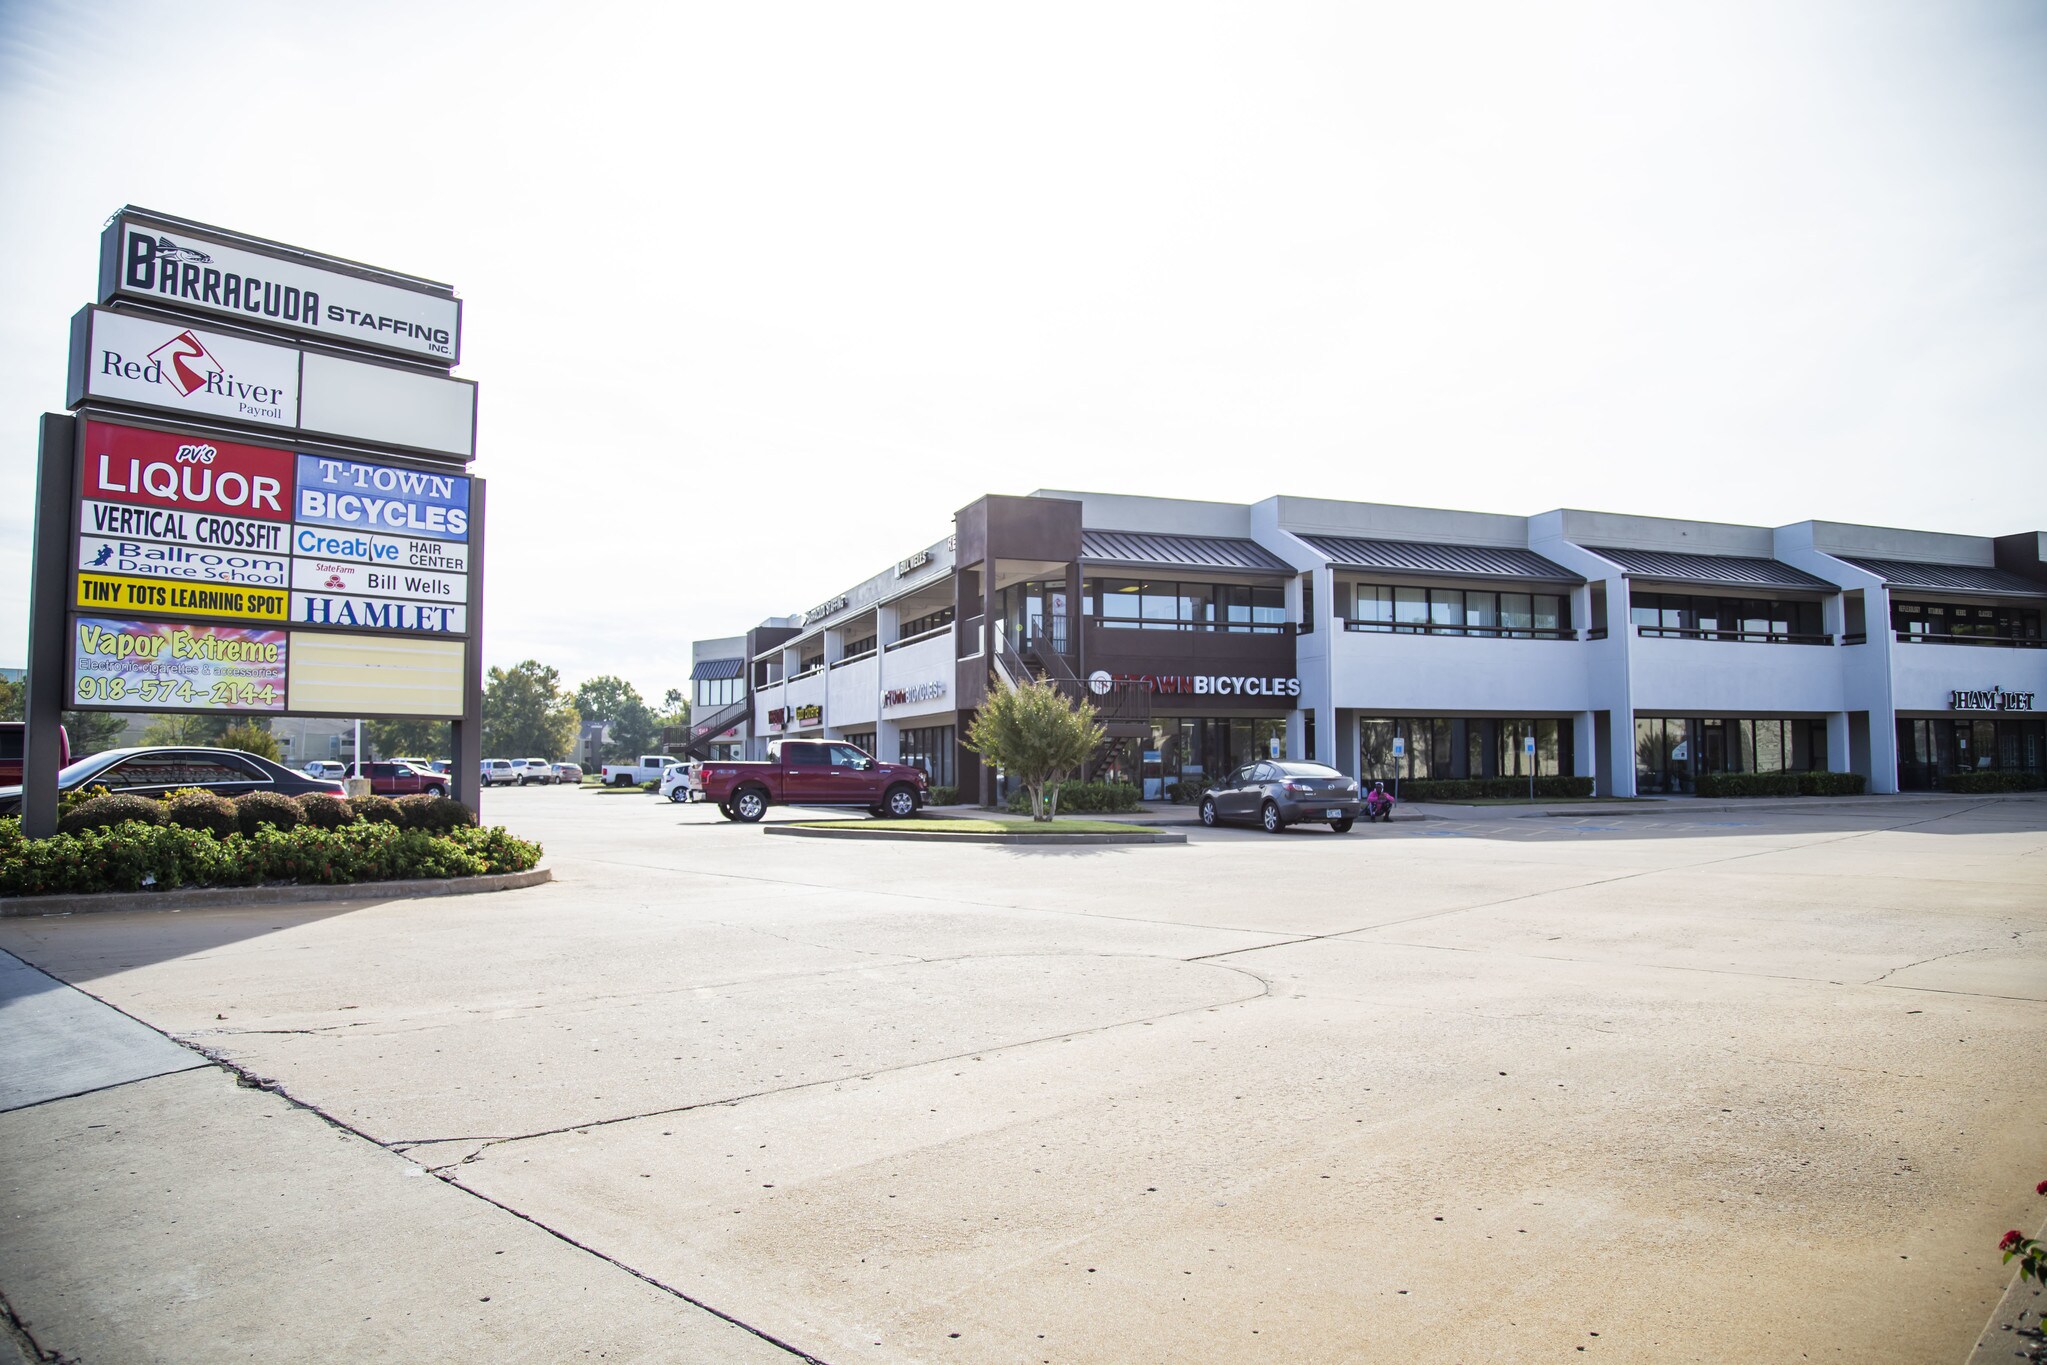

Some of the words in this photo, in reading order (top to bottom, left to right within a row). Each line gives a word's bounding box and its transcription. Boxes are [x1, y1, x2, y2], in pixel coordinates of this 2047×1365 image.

[126, 231, 319, 325] BARRACUDA
[327, 306, 449, 344] STAFFING
[429, 343, 452, 354] INC.
[101, 350, 162, 384] Red
[205, 370, 283, 405] River
[239, 403, 281, 419] Payroll
[98, 455, 282, 511] LIQUOR
[319, 460, 454, 498] T-TOWN
[94, 504, 187, 540] VERTICAL
[196, 517, 281, 550] CROSSFIT
[302, 490, 467, 535] BICYCLES
[119, 543, 283, 572] Ballroom
[409, 541, 441, 555] HAIR
[409, 554, 463, 570] CENTER
[119, 559, 196, 577] Dance
[205, 567, 283, 585] School
[368, 574, 396, 591] Bill
[405, 578, 450, 595] Wells
[83, 580, 121, 602] TINY
[127, 584, 165, 606] TOTS
[171, 589, 243, 612] LEARNING
[247, 595, 283, 614] SPOT
[304, 597, 454, 632] HAMLET
[80, 625, 165, 660] Vapor
[172, 631, 278, 663] Extreme
[79, 658, 140, 673] Electronic
[142, 662, 198, 678] cigarettes
[202, 666, 210, 675] &
[213, 667, 278, 679] accessories
[78, 676, 278, 705] 918-574-2144
[1194, 675, 1299, 696] BICYCLES
